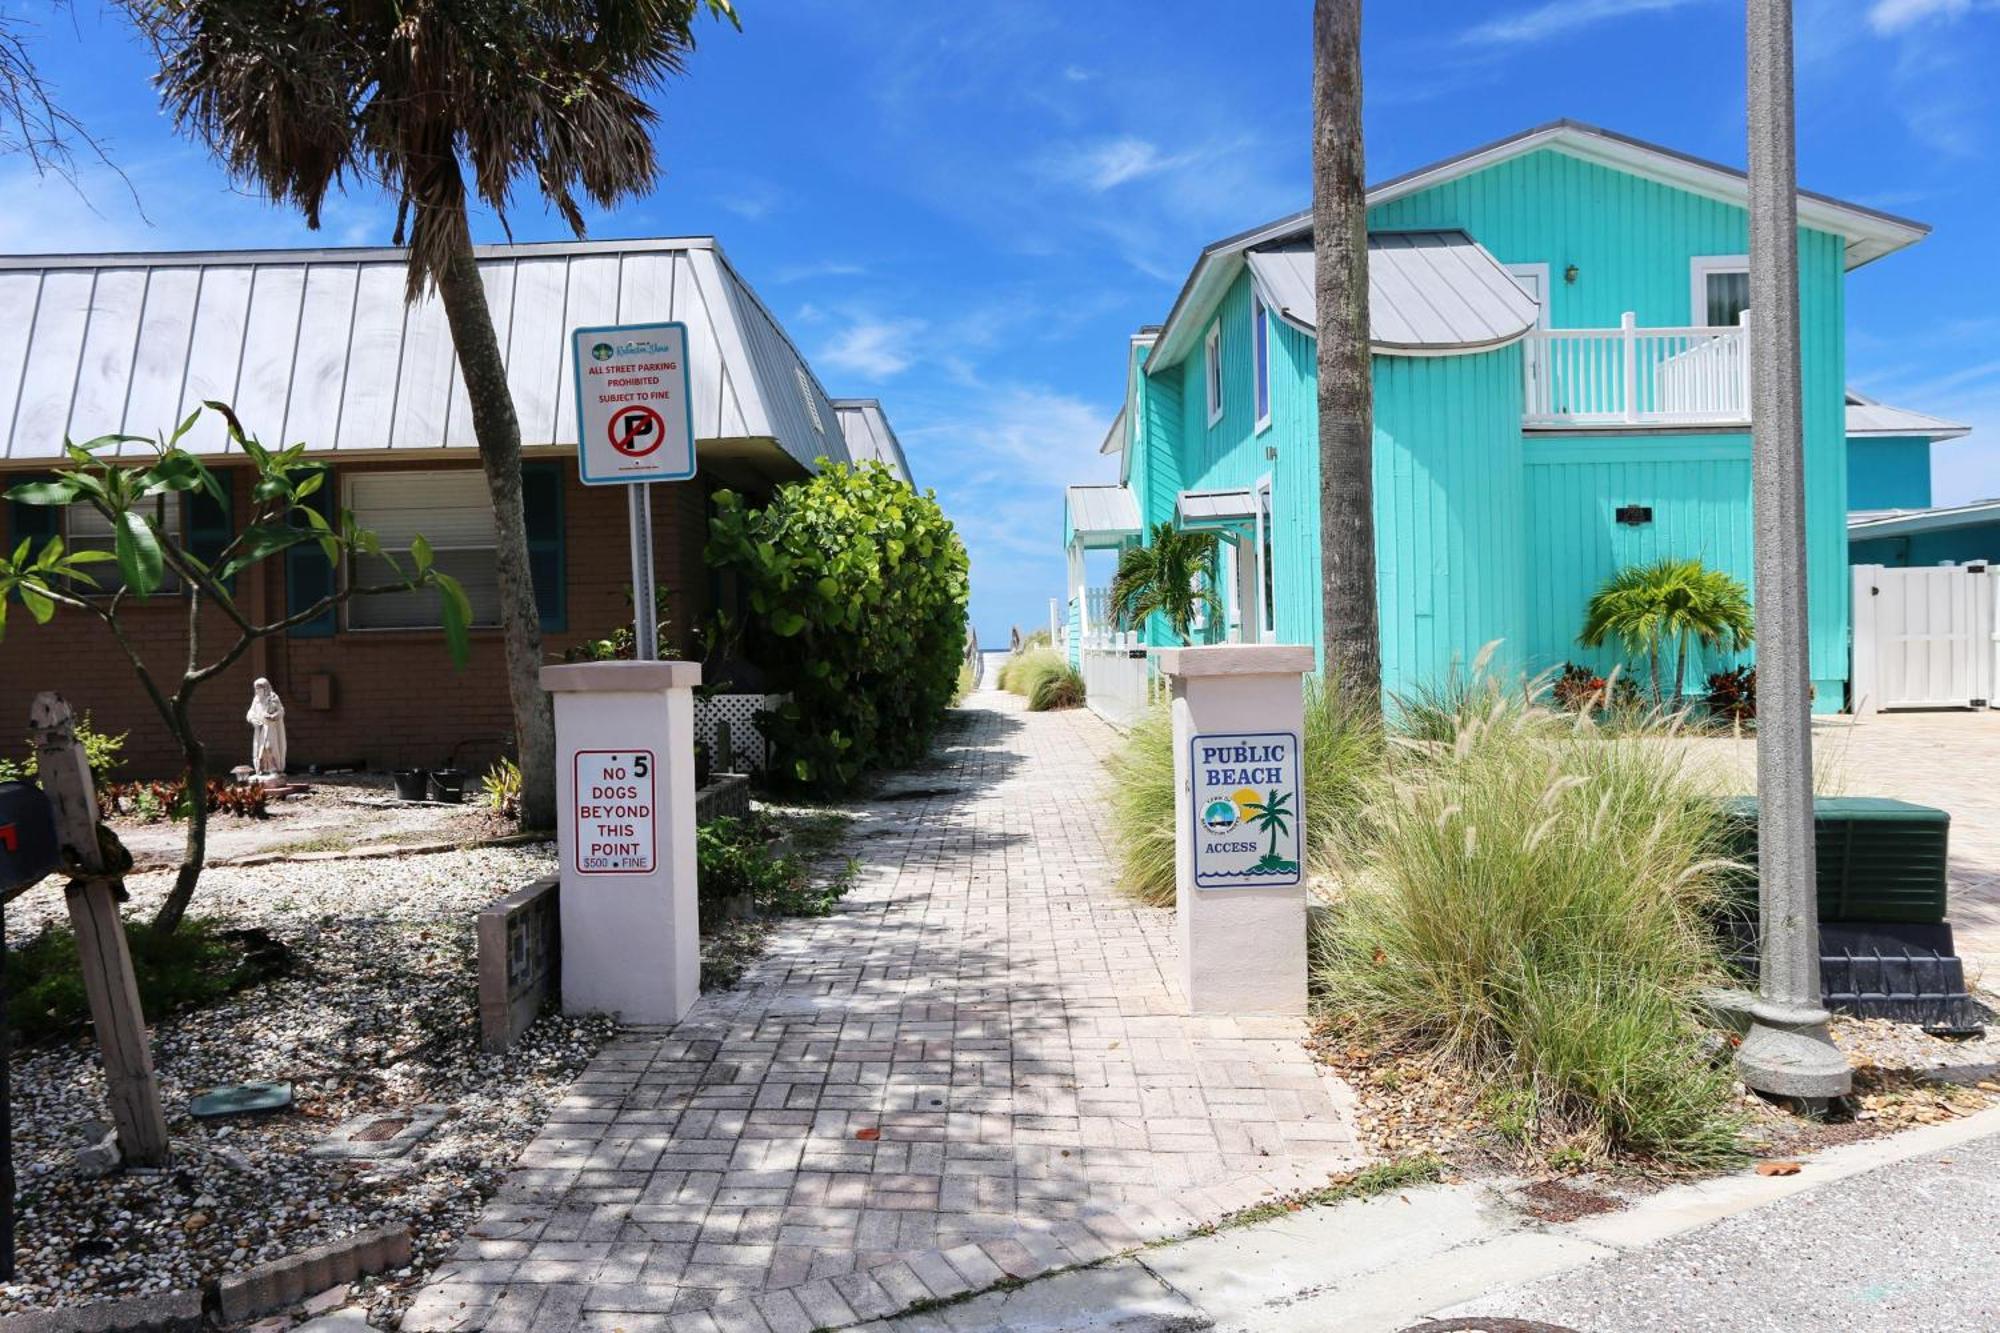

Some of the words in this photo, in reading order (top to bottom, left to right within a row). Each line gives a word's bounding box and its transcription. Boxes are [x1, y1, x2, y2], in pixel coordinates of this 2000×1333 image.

[589, 366, 603, 375] ALL
[606, 364, 636, 374] STREET
[638, 362, 677, 372] PARKING
[608, 376, 660, 387] PROHIBITED
[599, 393, 634, 403] SUBJECT
[637, 392, 649, 401] TO
[651, 391, 670, 400] FINE
[1202, 745, 1285, 764] PUBLIC
[603, 767, 626, 780] NO
[634, 756, 648, 778] 5
[1206, 767, 1282, 786] BEACH
[592, 786, 638, 799] DOGS
[581, 805, 650, 819] BEYOND
[597, 824, 634, 837] THIS
[591, 843, 640, 856] POINT
[1205, 842, 1257, 854] ACCESS
[583, 857, 608, 868] $500
[622, 857, 647, 868] FINE
